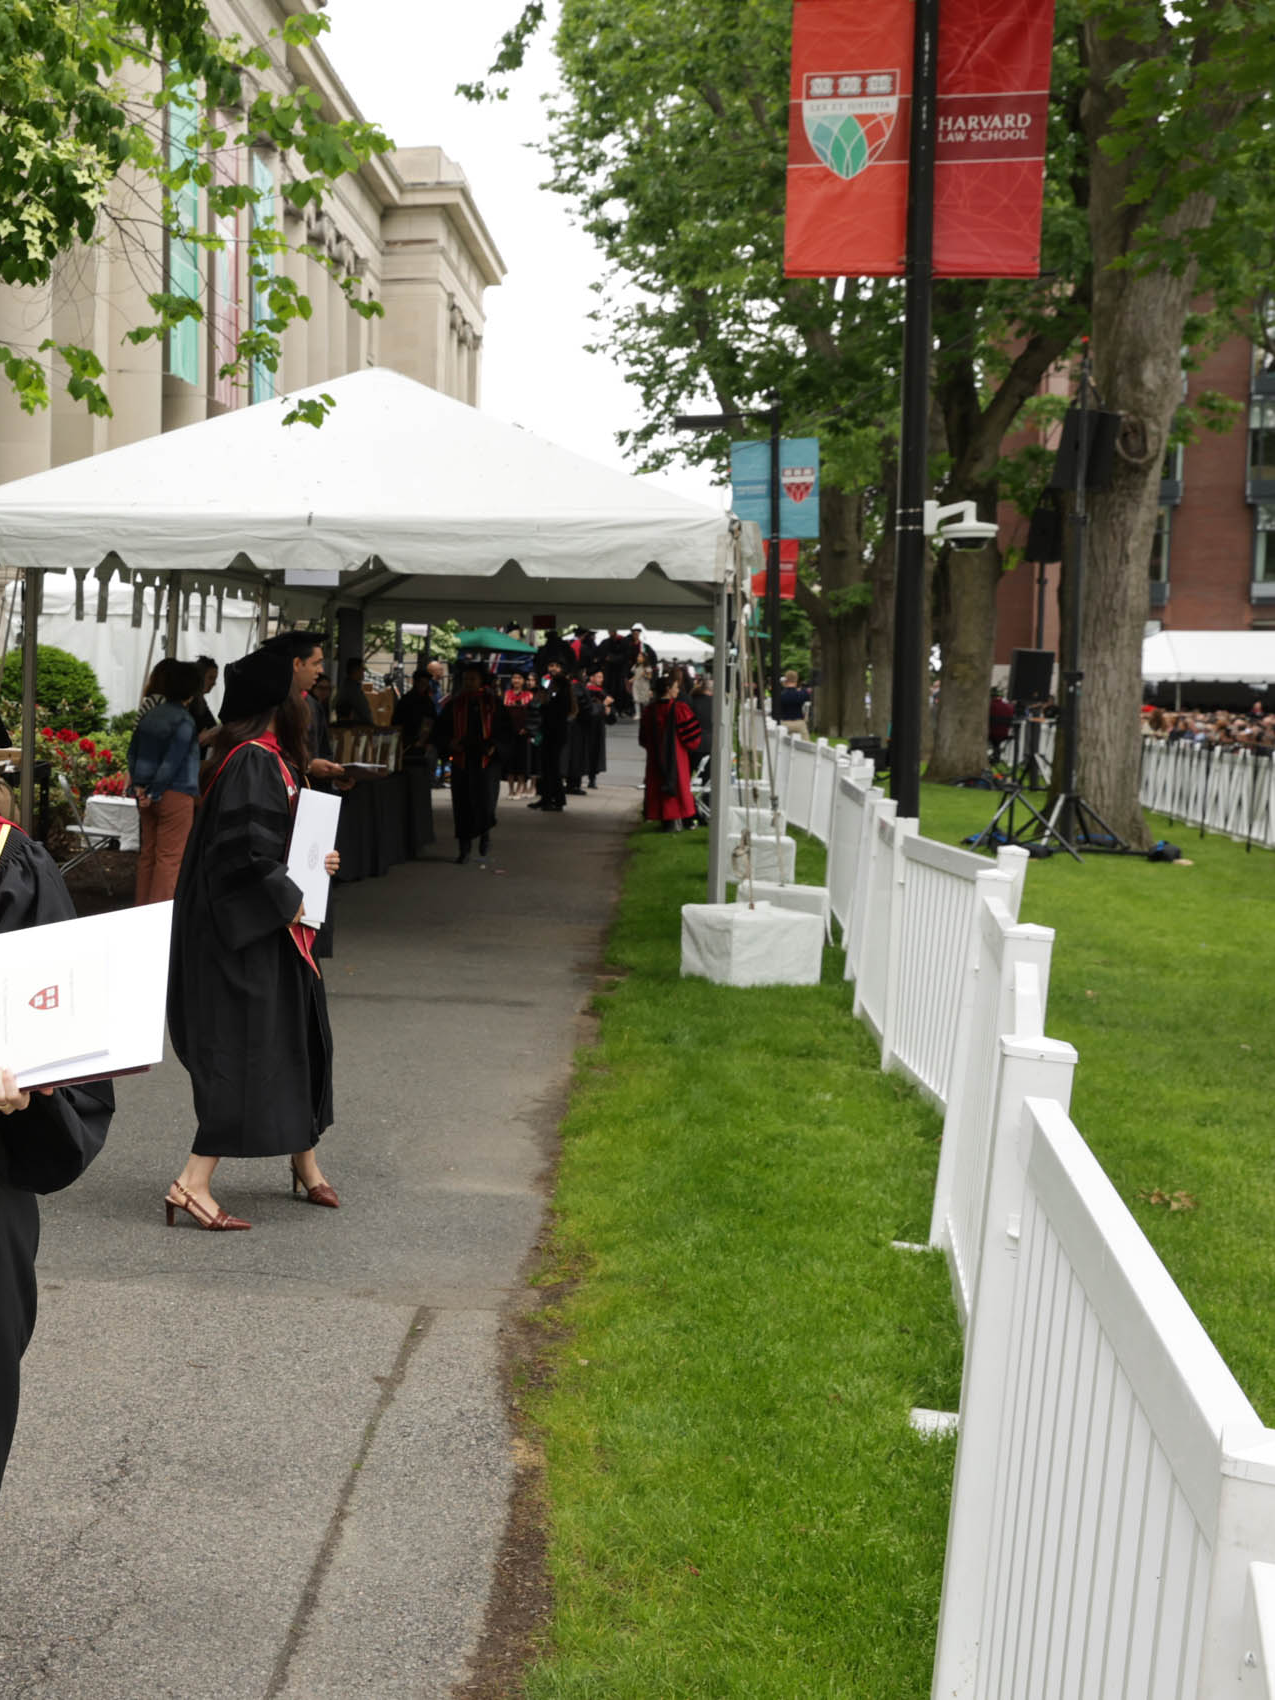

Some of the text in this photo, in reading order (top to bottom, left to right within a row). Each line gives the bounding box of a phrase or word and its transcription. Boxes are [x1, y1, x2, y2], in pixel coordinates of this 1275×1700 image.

[938, 112, 1032, 131] HARVARD
[937, 129, 1029, 143] LAW SCHOOL
